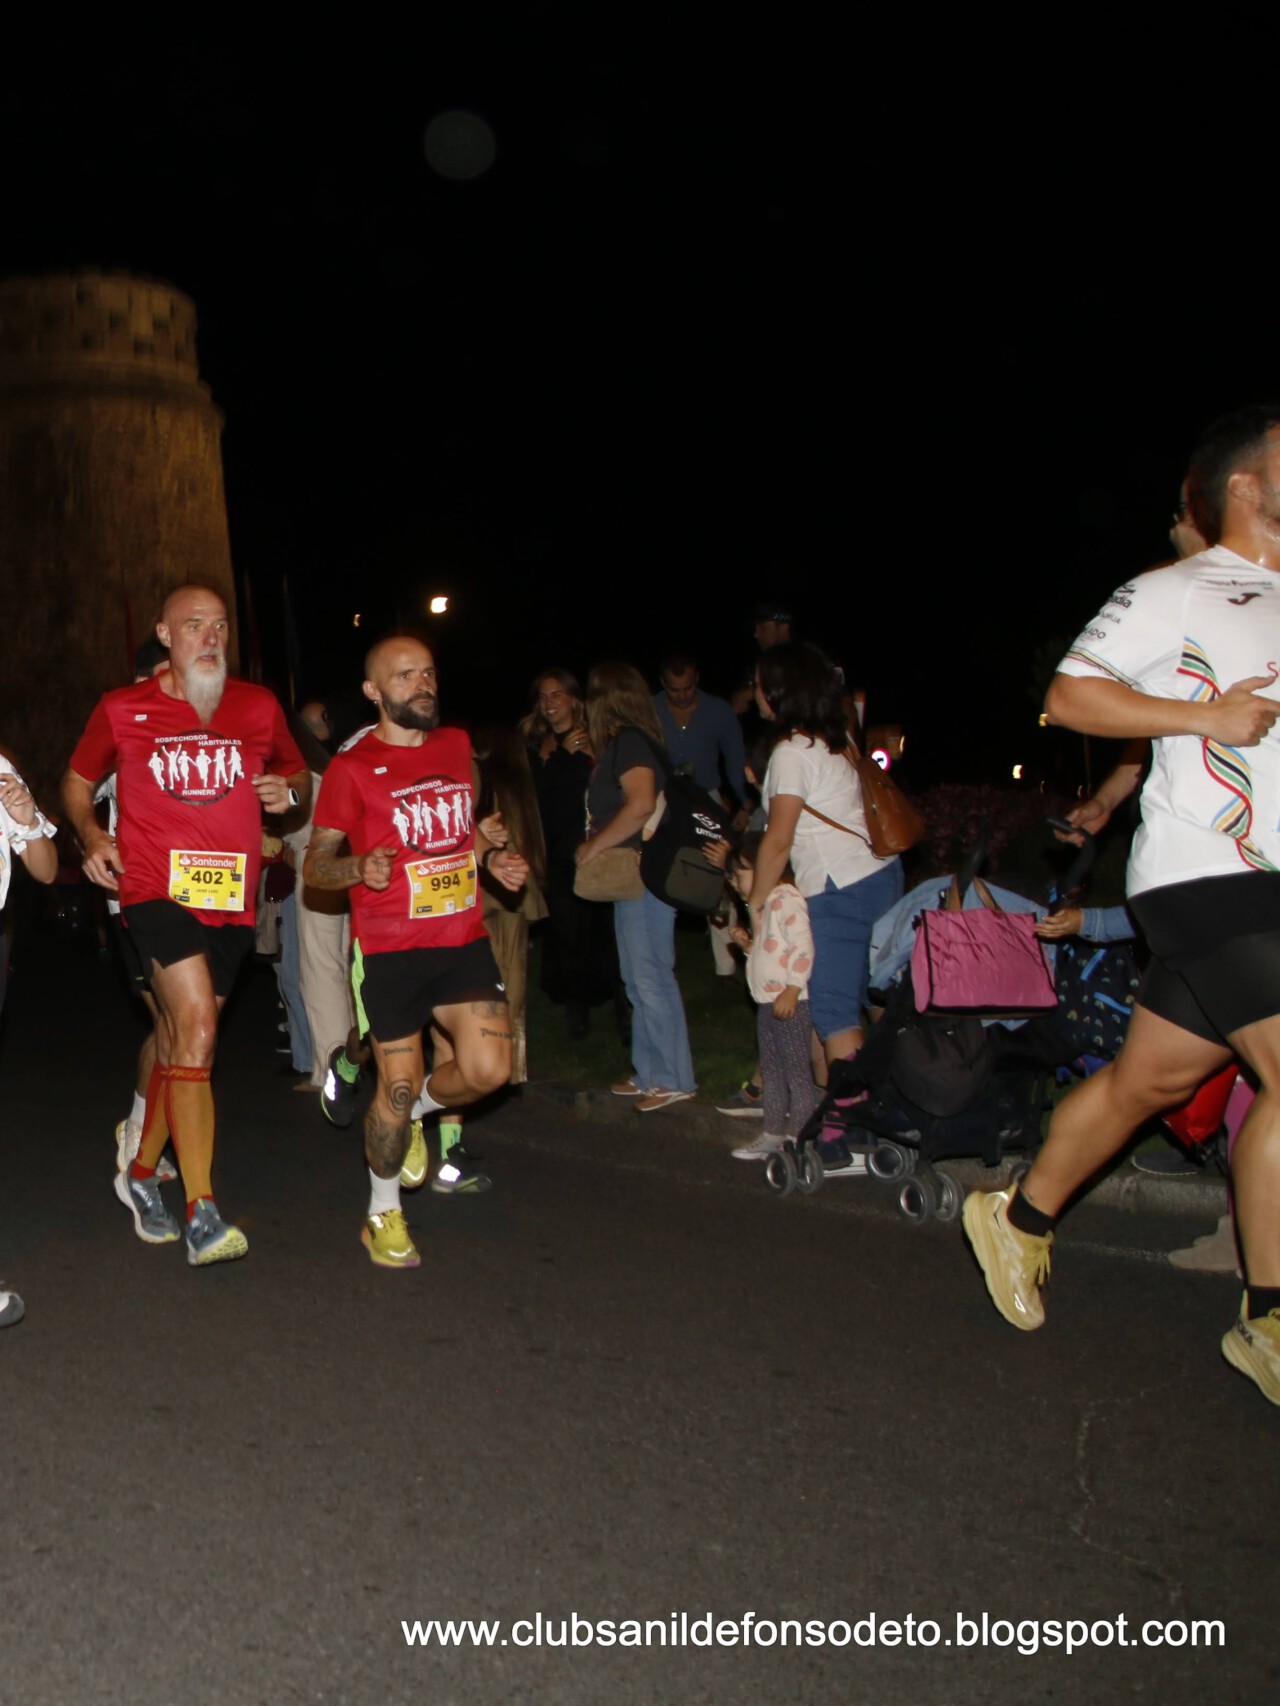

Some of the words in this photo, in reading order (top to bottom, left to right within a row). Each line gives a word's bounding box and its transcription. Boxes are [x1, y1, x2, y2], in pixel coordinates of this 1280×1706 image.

[155, 734, 208, 743] SOSPECHOSOS
[182, 788, 217, 796] RUNNERS
[391, 780, 443, 798] SOSPECHOSOS
[425, 837, 458, 849] RUNNERS
[191, 856, 237, 868] Santander
[429, 857, 469, 874] Santander
[191, 870, 224, 885] 402
[430, 873, 462, 892] 994
